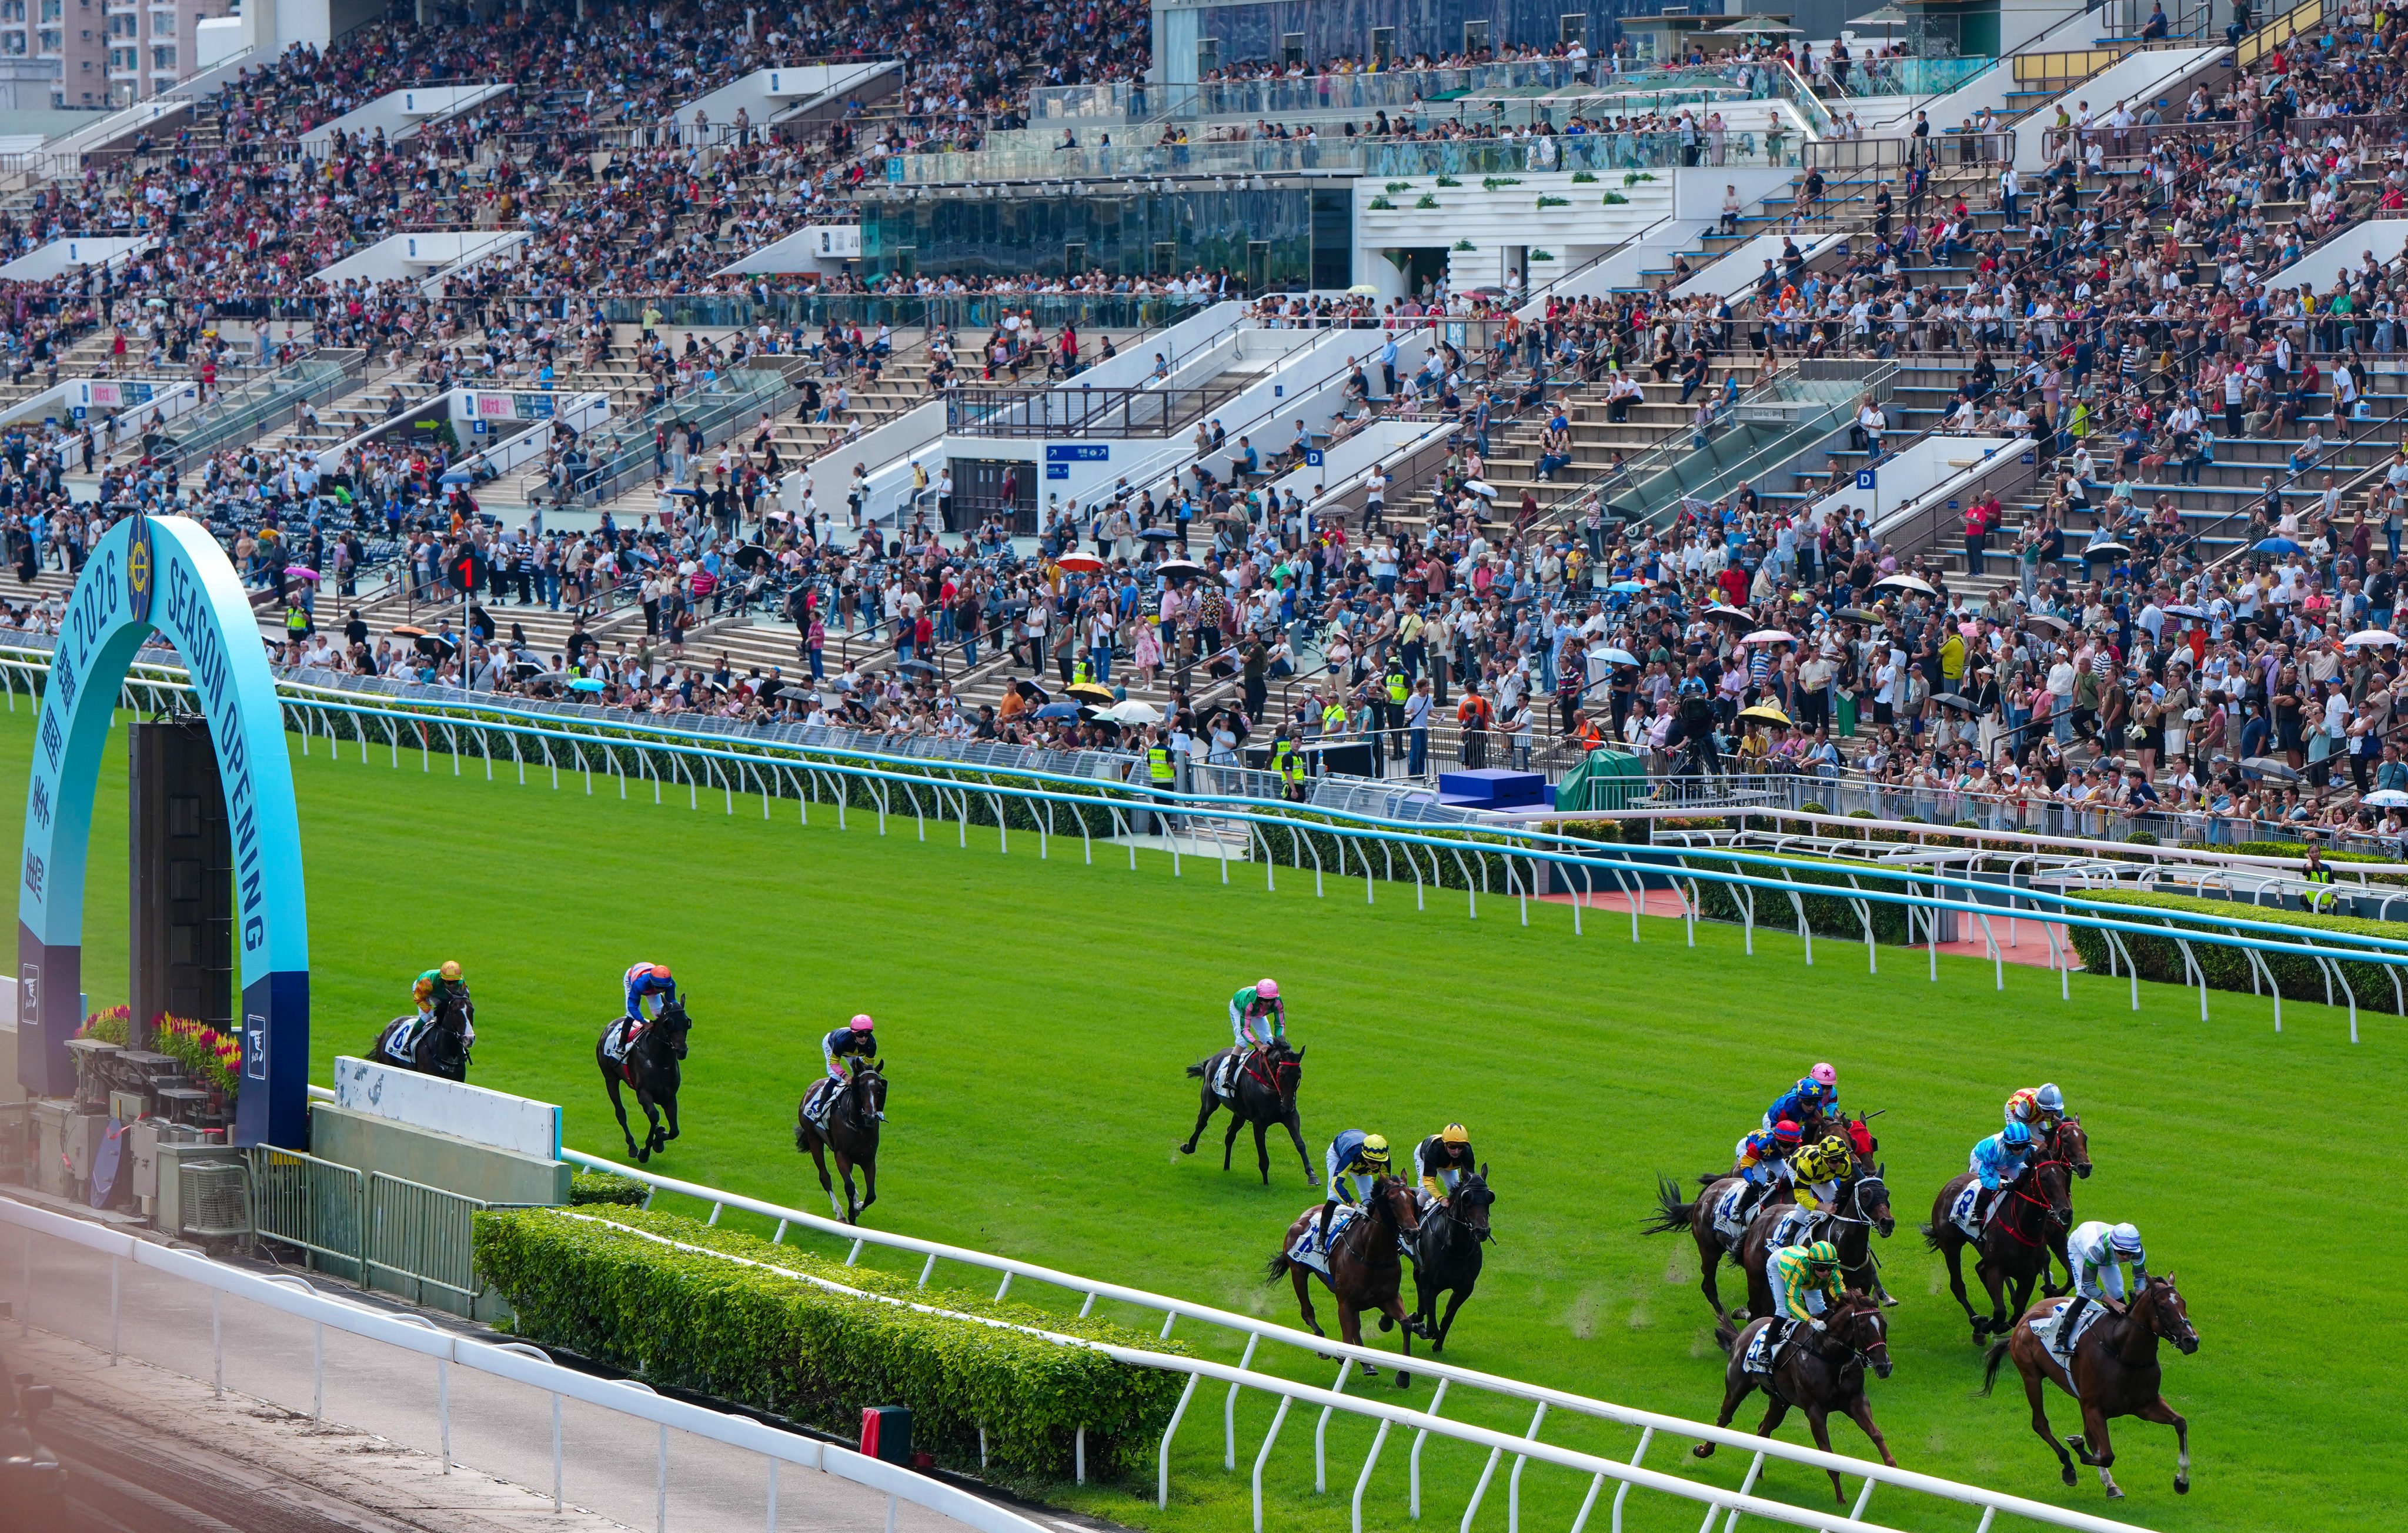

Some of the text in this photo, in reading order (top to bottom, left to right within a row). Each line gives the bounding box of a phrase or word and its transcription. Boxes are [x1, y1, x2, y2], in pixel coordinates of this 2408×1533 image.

[1450, 323, 1462, 338] D6
[476, 423, 483, 432] E
[1310, 453, 1318, 463] D
[1861, 474, 1871, 486] D
[458, 558, 473, 587] 1
[74, 550, 117, 669] 2026
[168, 557, 263, 951] SEASON OPENING
[393, 1025, 410, 1049] 6
